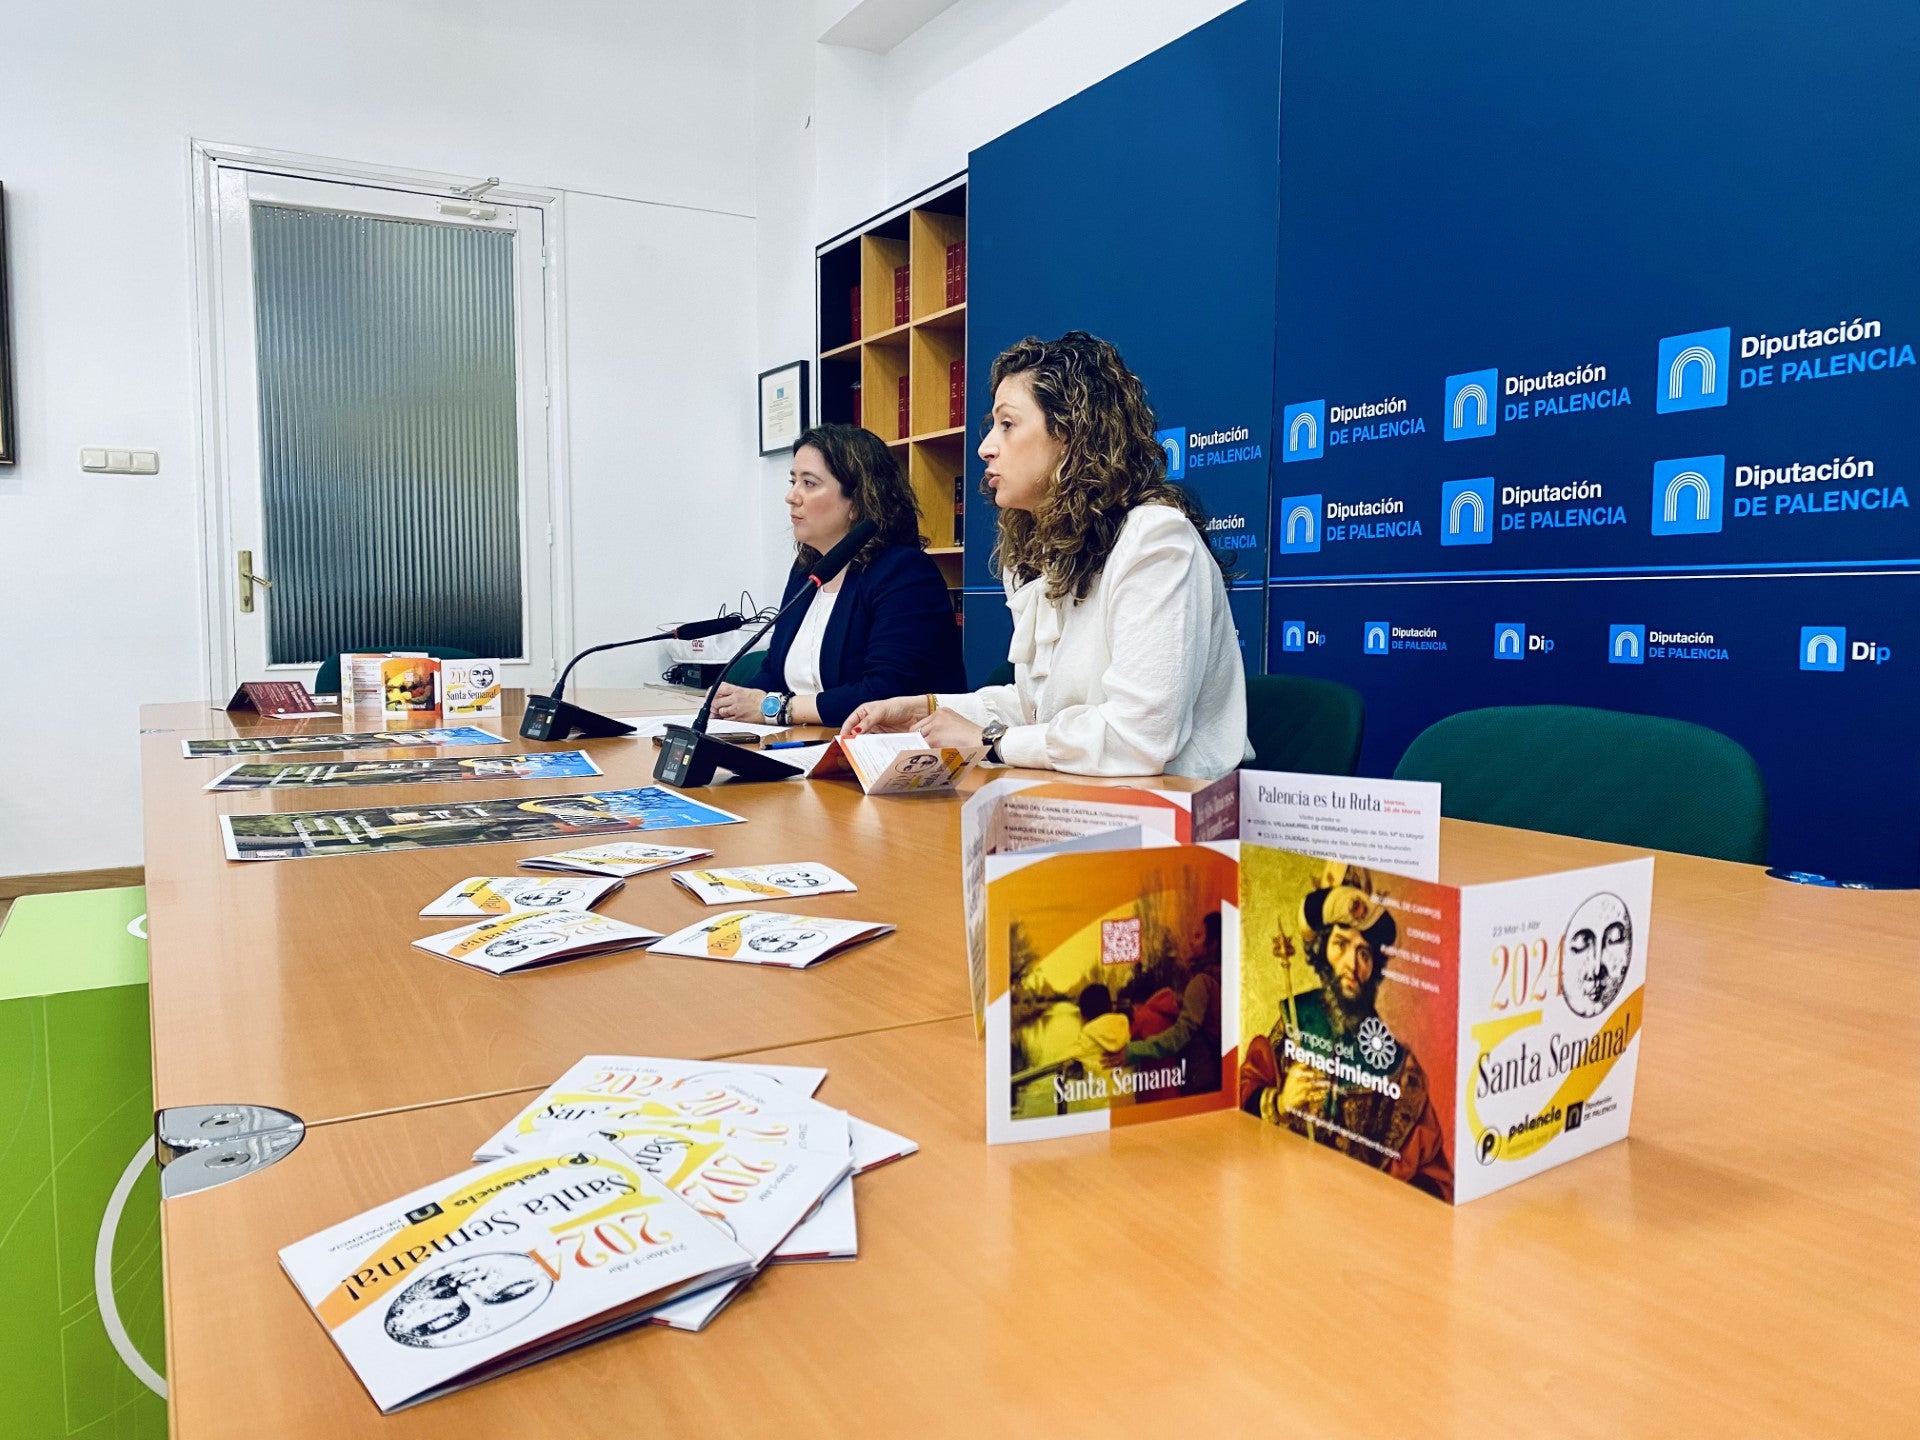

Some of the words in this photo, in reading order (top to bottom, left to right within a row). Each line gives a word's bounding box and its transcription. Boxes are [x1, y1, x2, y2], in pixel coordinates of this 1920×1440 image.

[1740, 317, 1881, 360] Diputación
[1505, 363, 1607, 397] Diputación
[1740, 364, 1773, 389] DE
[1781, 344, 1917, 384] PALENCIA
[1330, 397, 1407, 423] Diputación
[1504, 401, 1529, 422] DE
[1534, 386, 1632, 418] PALENCIA
[1189, 426, 1249, 449] Diputación
[1329, 429, 1349, 446] DE
[1352, 417, 1426, 443] PALENCIA
[1189, 453, 1206, 468] DE
[1206, 445, 1262, 467] PALENCIA
[1735, 456, 1874, 490] Diputación
[1501, 480, 1602, 508] Diputación
[1734, 496, 1767, 518] DE
[1775, 486, 1910, 515] PALENCIA
[1327, 497, 1404, 522] Diputación
[1501, 512, 1525, 531] DE
[1530, 505, 1627, 529] PALENCIA
[1326, 526, 1346, 541] DE
[1349, 519, 1423, 539] PALENCIA
[1307, 630, 1326, 647] Dip
[1391, 640, 1404, 650] DE
[1405, 640, 1448, 652] PALENCIA
[1392, 627, 1438, 640] Diputación
[1528, 634, 1555, 653] Dip
[1649, 631, 1714, 646] Diputación
[1648, 647, 1666, 659] DE
[1668, 647, 1729, 661] PALENCIA
[1851, 641, 1892, 665] Dip
[1258, 785, 1309, 807] Palencia
[1313, 794, 1328, 808] es
[1332, 791, 1346, 809] tu
[1350, 793, 1381, 812] Ruta
[1489, 934, 1566, 1011] 2024
[1285, 1023, 1333, 1052] Campos
[1335, 1042, 1354, 1060] del
[1477, 1043, 1542, 1098] Santa
[1549, 1013, 1631, 1079] Semana!
[1053, 1072, 1107, 1104] Santa
[1112, 1058, 1187, 1097] Semana!
[1284, 1039, 1401, 1100] Renacimiento
[1507, 1106, 1562, 1144] palencia
[454, 1167, 550, 1207] palencia
[523, 1173, 637, 1216] Santa
[341, 1210, 521, 1301] Semana!
[528, 1211, 673, 1283] 2024
